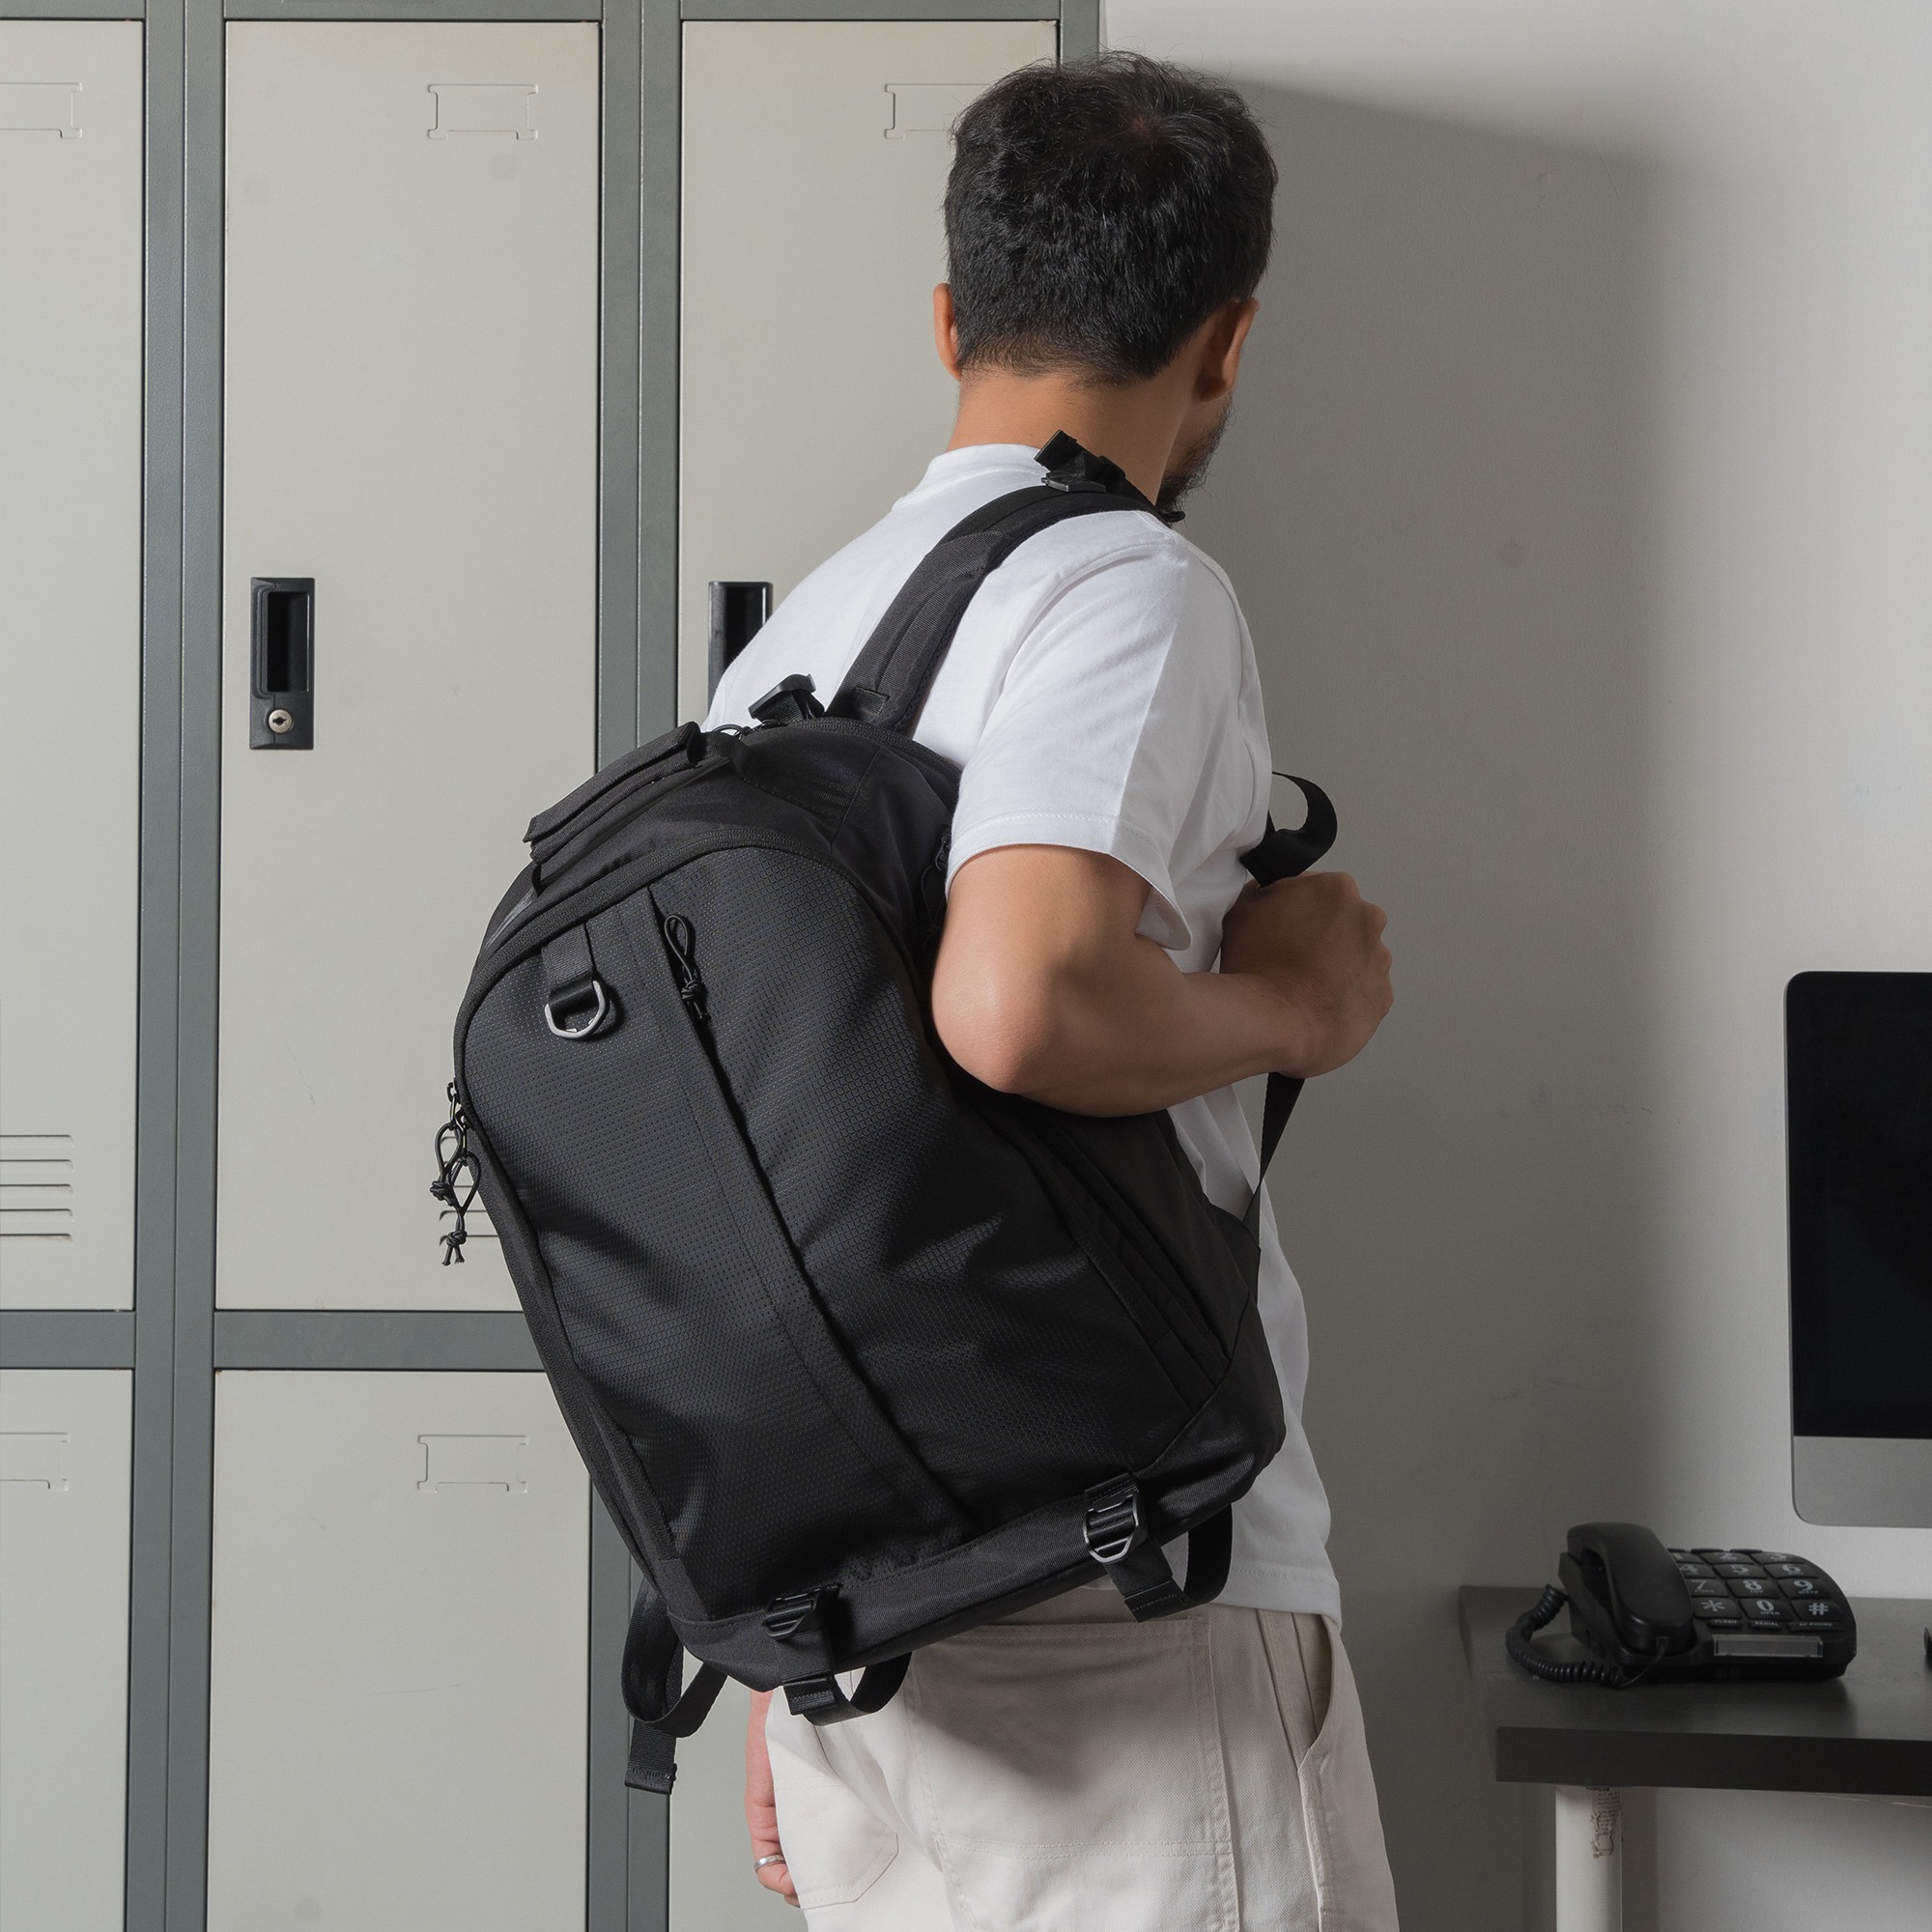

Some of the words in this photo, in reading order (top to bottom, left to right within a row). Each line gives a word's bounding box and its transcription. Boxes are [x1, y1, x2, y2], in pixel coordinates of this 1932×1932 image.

[1679, 1564, 1698, 1573] 4
[1730, 1564, 1748, 1573] 5
[1782, 1564, 1802, 1573] 6
[1691, 1579, 1707, 1590] 7
[1743, 1579, 1762, 1590] 8
[1793, 1579, 1813, 1591] 9
[1756, 1600, 1775, 1611] 0
[1808, 1602, 1829, 1615] #
